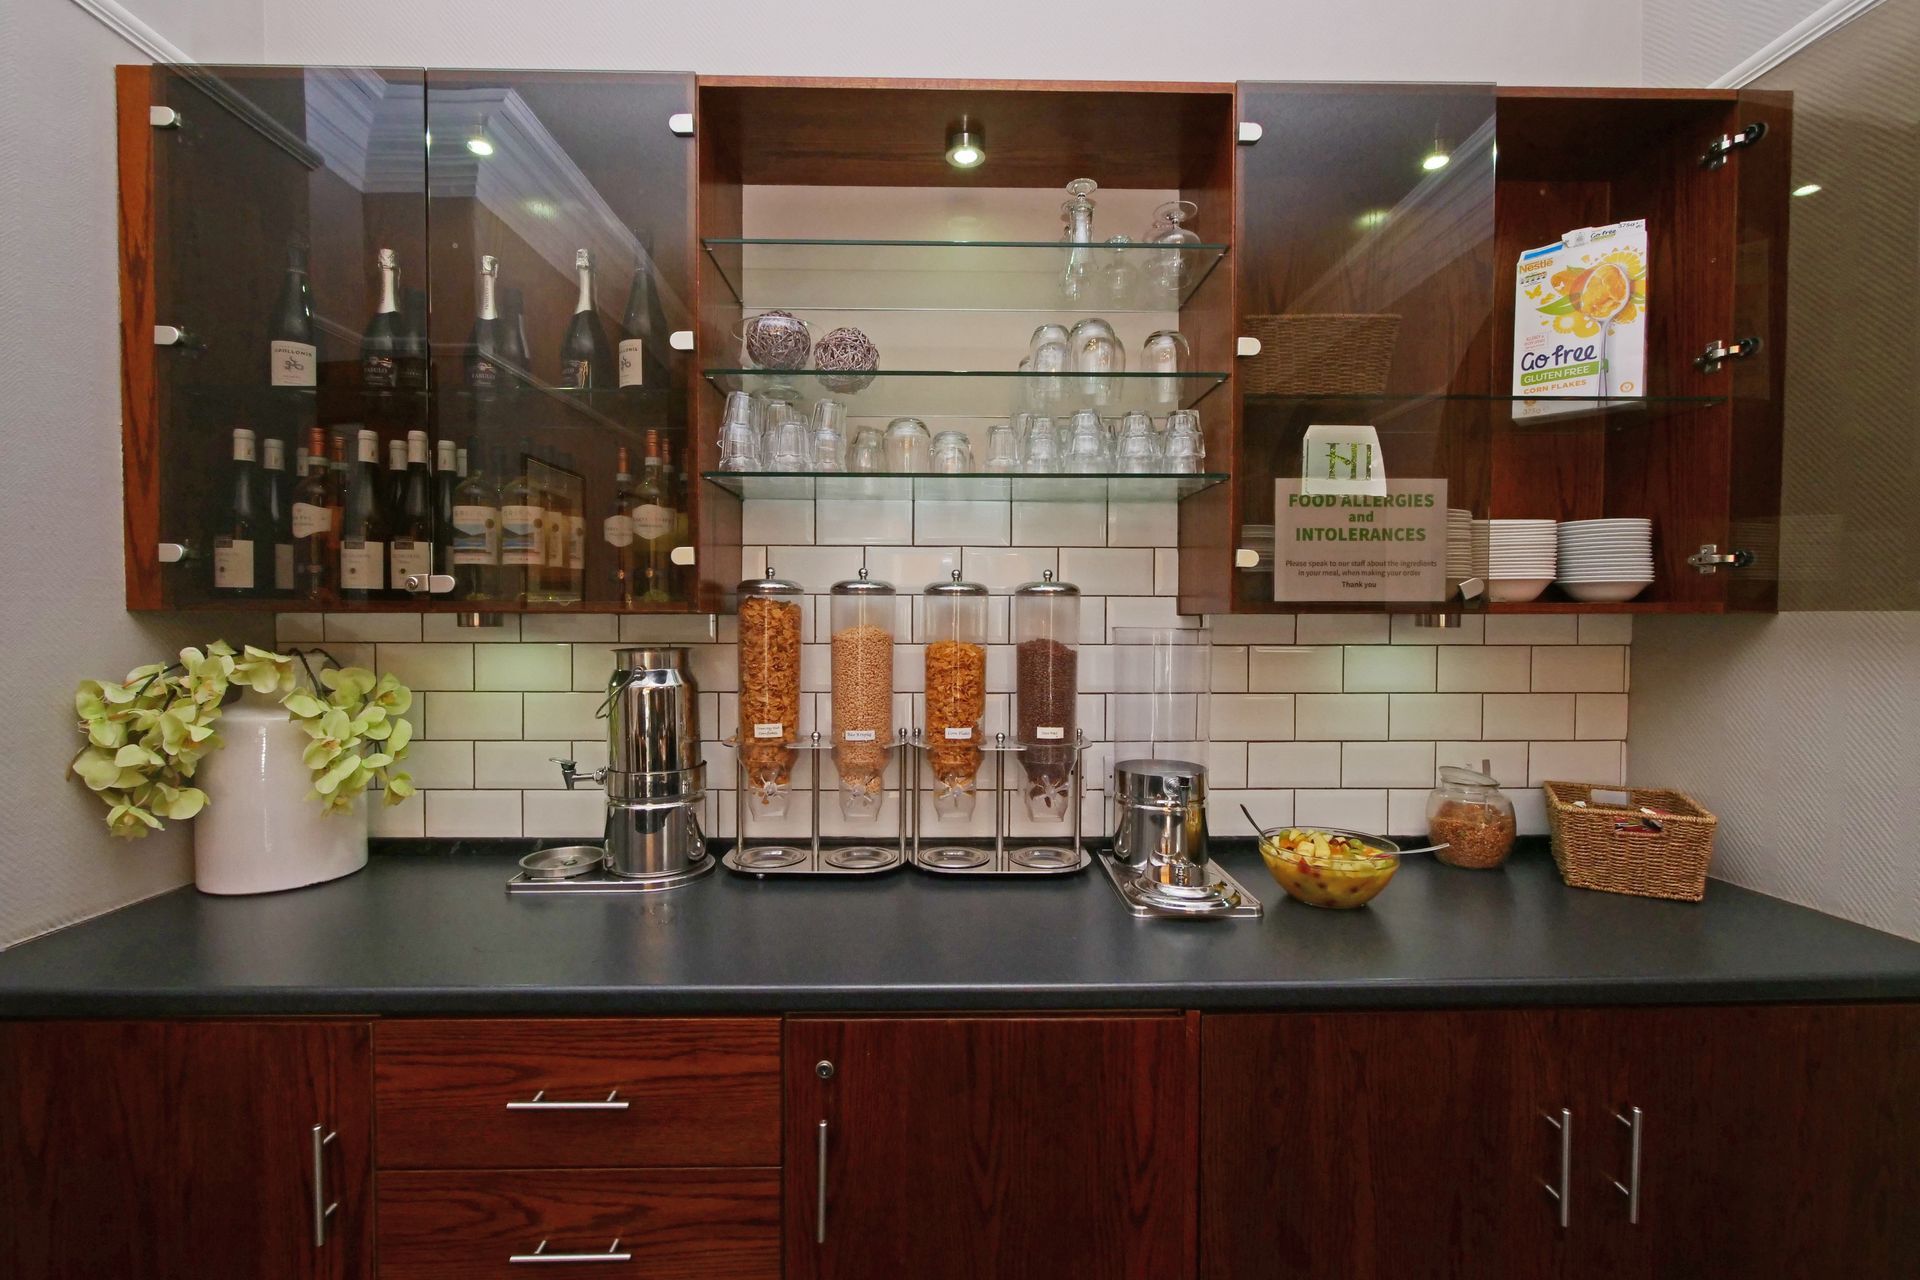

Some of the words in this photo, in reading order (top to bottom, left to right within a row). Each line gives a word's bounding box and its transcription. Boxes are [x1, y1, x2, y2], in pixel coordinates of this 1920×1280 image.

[1521, 352, 1550, 371] Go
[1551, 345, 1598, 366] free
[1523, 369, 1562, 384] GLUTEN
[1563, 365, 1590, 377] FREE
[1523, 385, 1549, 395] CORN
[1551, 380, 1587, 390] FLAKES
[1288, 493, 1337, 508] FOOD
[1340, 494, 1435, 508] ALLERGIES
[1348, 511, 1374, 523] and
[1295, 527, 1427, 542] INTOLERANCES
[1308, 560, 1328, 569] speak
[1400, 560, 1438, 569] ingredients
[1361, 569, 1386, 578] making
[1364, 582, 1377, 590] you
